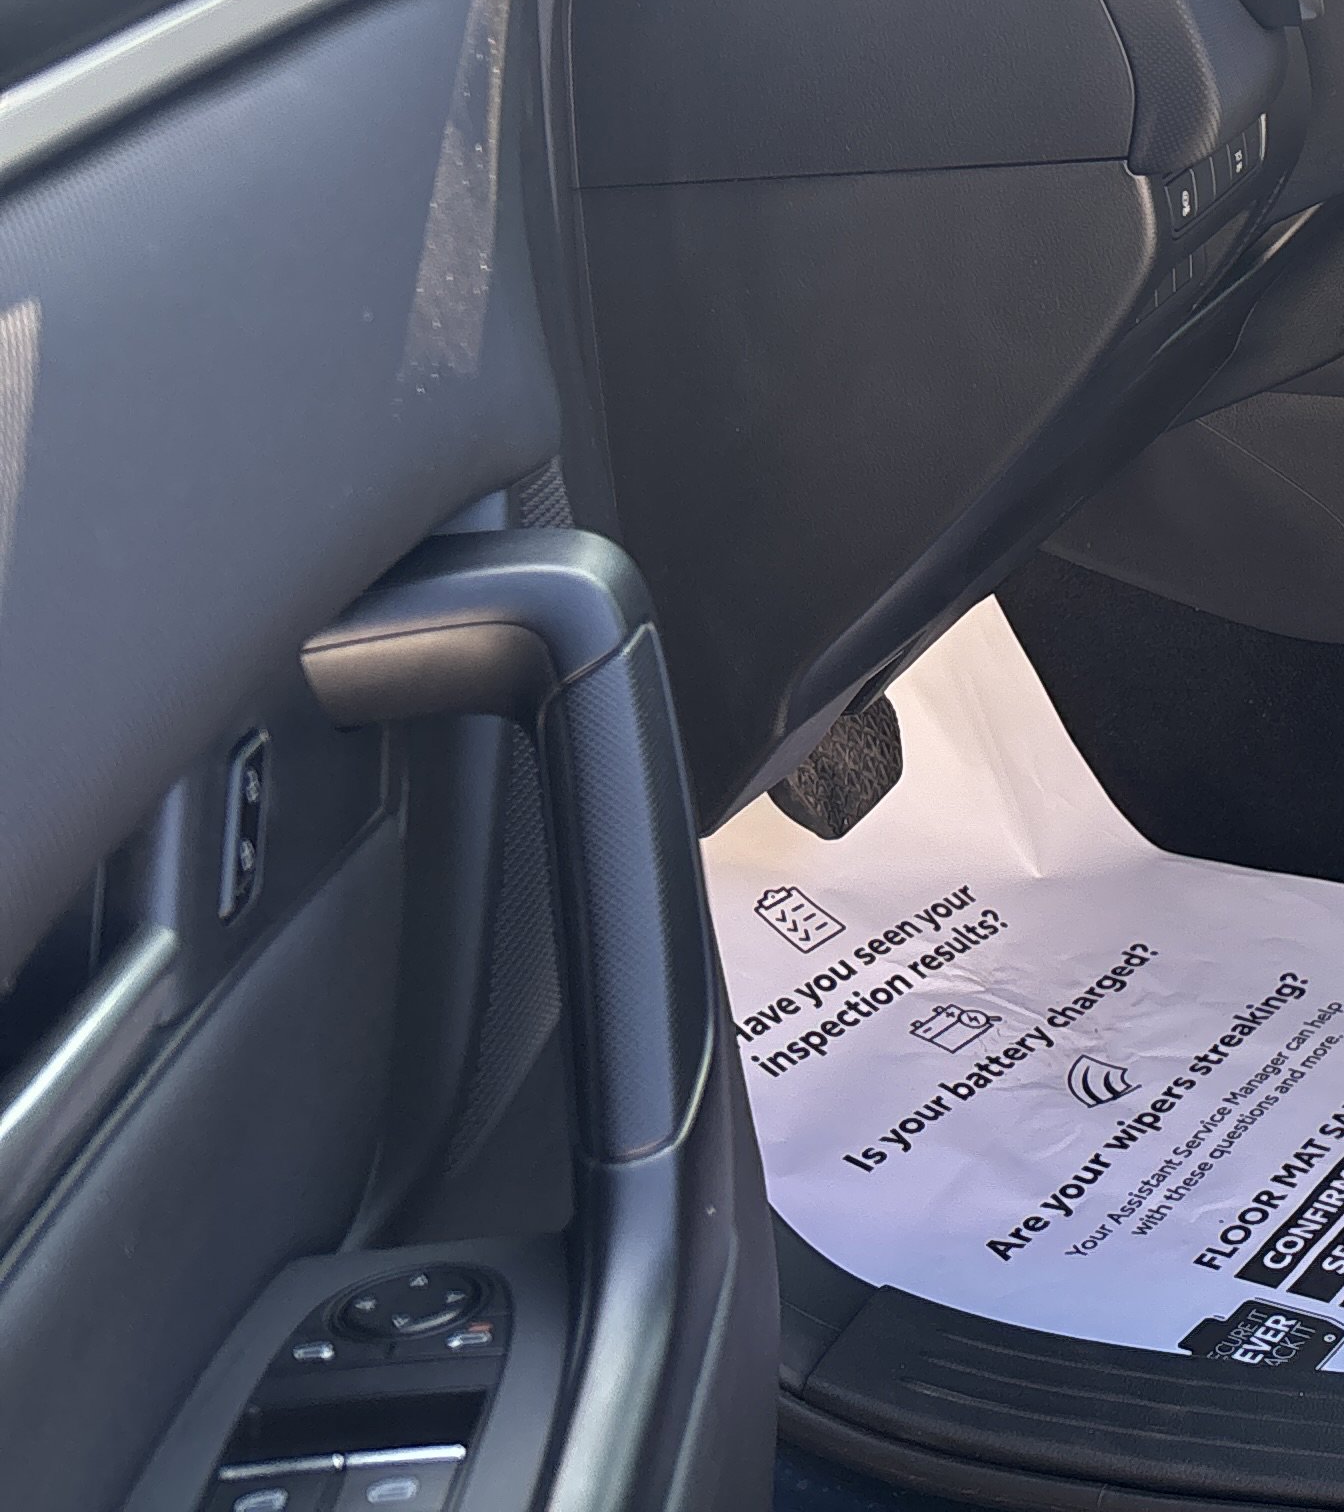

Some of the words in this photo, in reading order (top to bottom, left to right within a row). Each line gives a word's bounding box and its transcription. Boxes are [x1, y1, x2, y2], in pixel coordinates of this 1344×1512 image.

[751, 974, 913, 1077] inspection
[907, 909, 1008, 979] results?
[794, 959, 858, 1009] you
[853, 920, 923, 966] seen
[914, 885, 976, 932] your
[843, 1147, 888, 1173] Is
[879, 1095, 952, 1153] your
[938, 1026, 1054, 1101] battery
[1046, 943, 1158, 1028] charged?
[985, 1216, 1051, 1262] Are
[1040, 1152, 1111, 1218] your
[1103, 1077, 1196, 1150] wipers
[1189, 972, 1308, 1076] streaking?
[1065, 1223, 1113, 1256] Your
[1107, 1158, 1183, 1225] Assistant
[1172, 1106, 1233, 1159] Service
[1222, 1051, 1289, 1106] Manager
[1285, 1029, 1315, 1052] can
[1303, 1002, 1344, 1029] help
[1131, 1204, 1173, 1235] with
[1163, 1162, 1214, 1202] these
[1208, 1094, 1280, 1160] questions
[1274, 1067, 1306, 1094] and
[1300, 1035, 1344, 1069] more.
[1193, 1190, 1288, 1271] FLOOR
[1270, 1138, 1331, 1189] MAT
